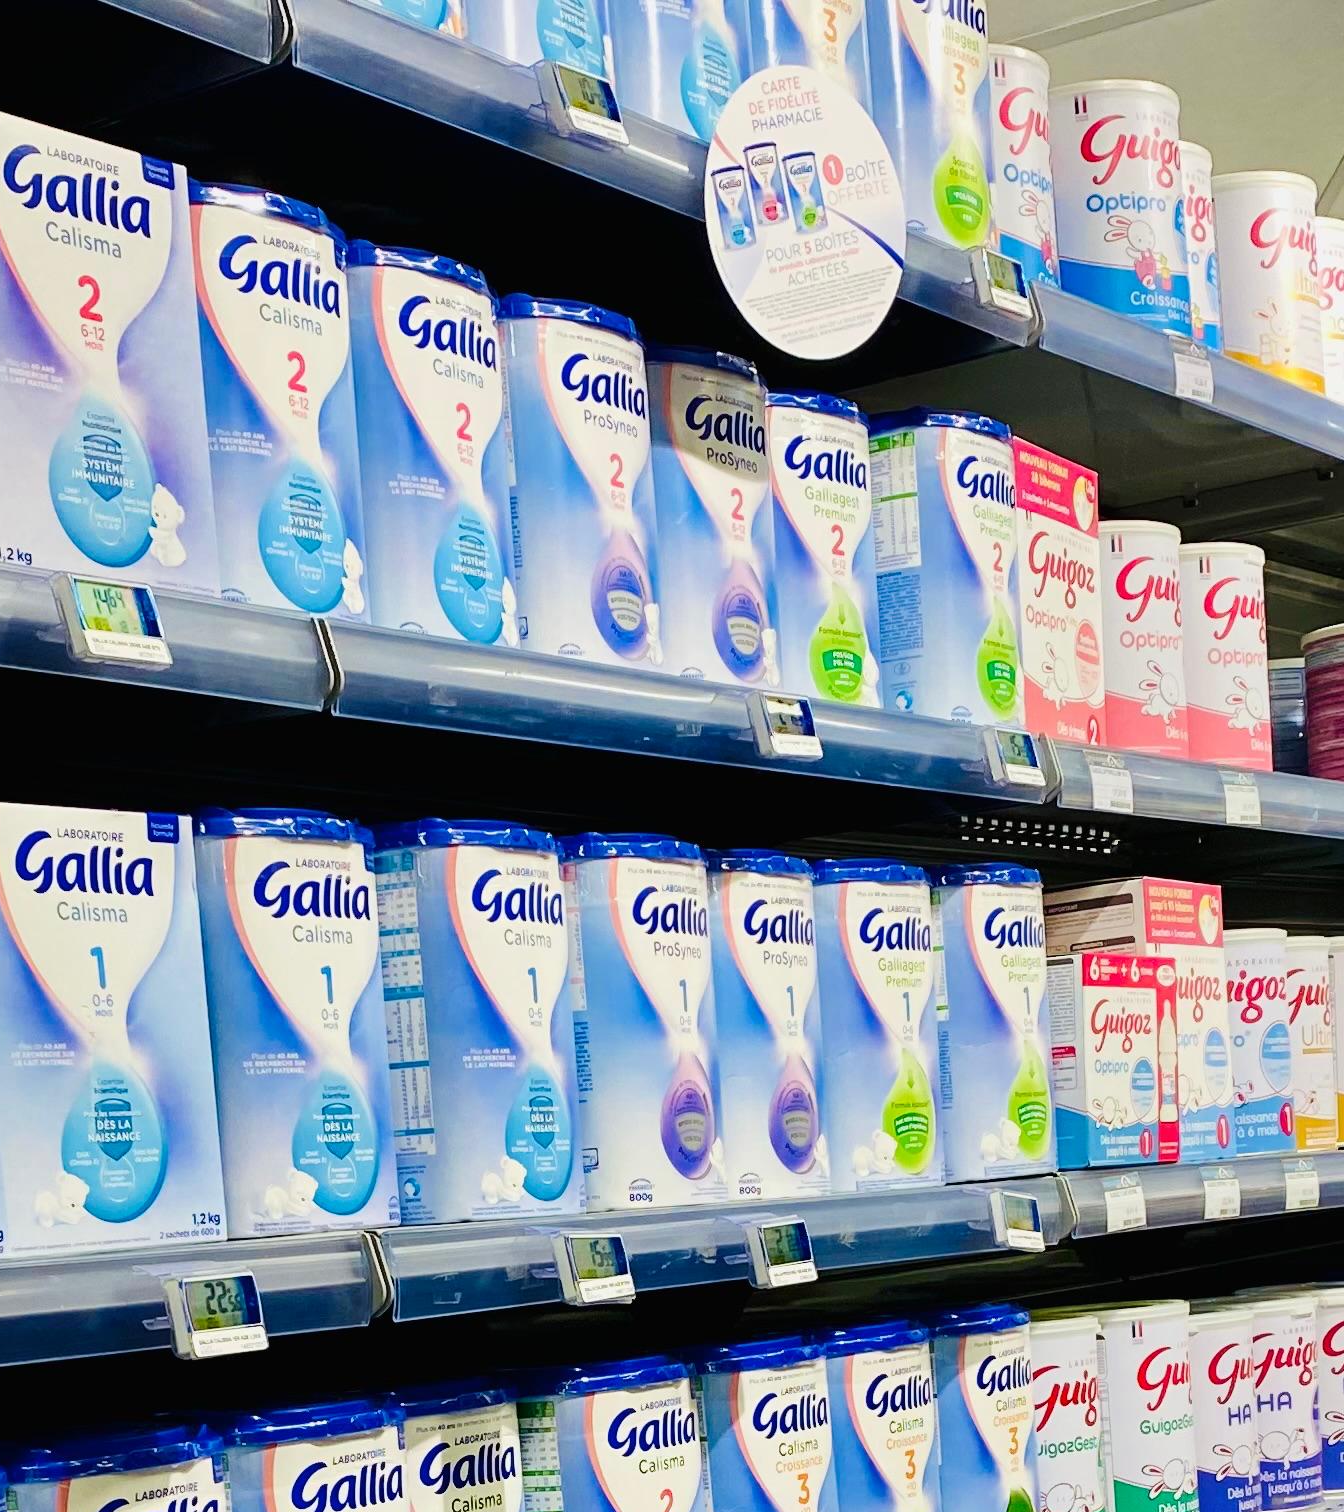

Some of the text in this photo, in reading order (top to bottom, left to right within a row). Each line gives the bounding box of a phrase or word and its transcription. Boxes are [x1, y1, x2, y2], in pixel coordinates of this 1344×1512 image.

[762, 76, 800, 96] CARTE
[749, 90, 819, 116] DE FIDÉLITÉ
[752, 108, 823, 132] PHARMACIE
[846, 160, 887, 184] BOÎTE
[3, 144, 152, 239] Gallia
[827, 179, 889, 207] OFFERTE
[1086, 192, 1166, 214] Optipro
[46, 222, 123, 259] Calisma
[766, 231, 858, 263] POUR 5 BOÎTES
[219, 235, 341, 319] Gallia
[788, 261, 849, 287] ACHETÉES
[259, 303, 323, 337] Calisma
[560, 352, 646, 421] Gallia
[583, 409, 639, 439] ProSyneo
[784, 435, 867, 491] Gallia
[804, 484, 859, 511] Galliagest
[813, 503, 857, 525] Premium
[16, 548, 32, 565] kg
[1027, 531, 1095, 609] Guigoz
[1025, 605, 1066, 632] Optipro
[1120, 631, 1178, 651] Optipro
[14, 831, 154, 897] Gallia
[253, 861, 371, 921] Gallia
[57, 901, 128, 925] Calisma
[631, 886, 708, 938] Gallia
[292, 924, 353, 945] Calisma
[859, 908, 931, 953] Gallia
[653, 941, 702, 960] ProSyneo
[878, 957, 925, 975] Galliagest
[886, 974, 922, 988] Premium
[1090, 1000, 1152, 1052] Guigoz
[1095, 1060, 1129, 1074] Optipro
[752, 1392, 828, 1439] Gallia
[775, 1455, 824, 1473] Croissance
